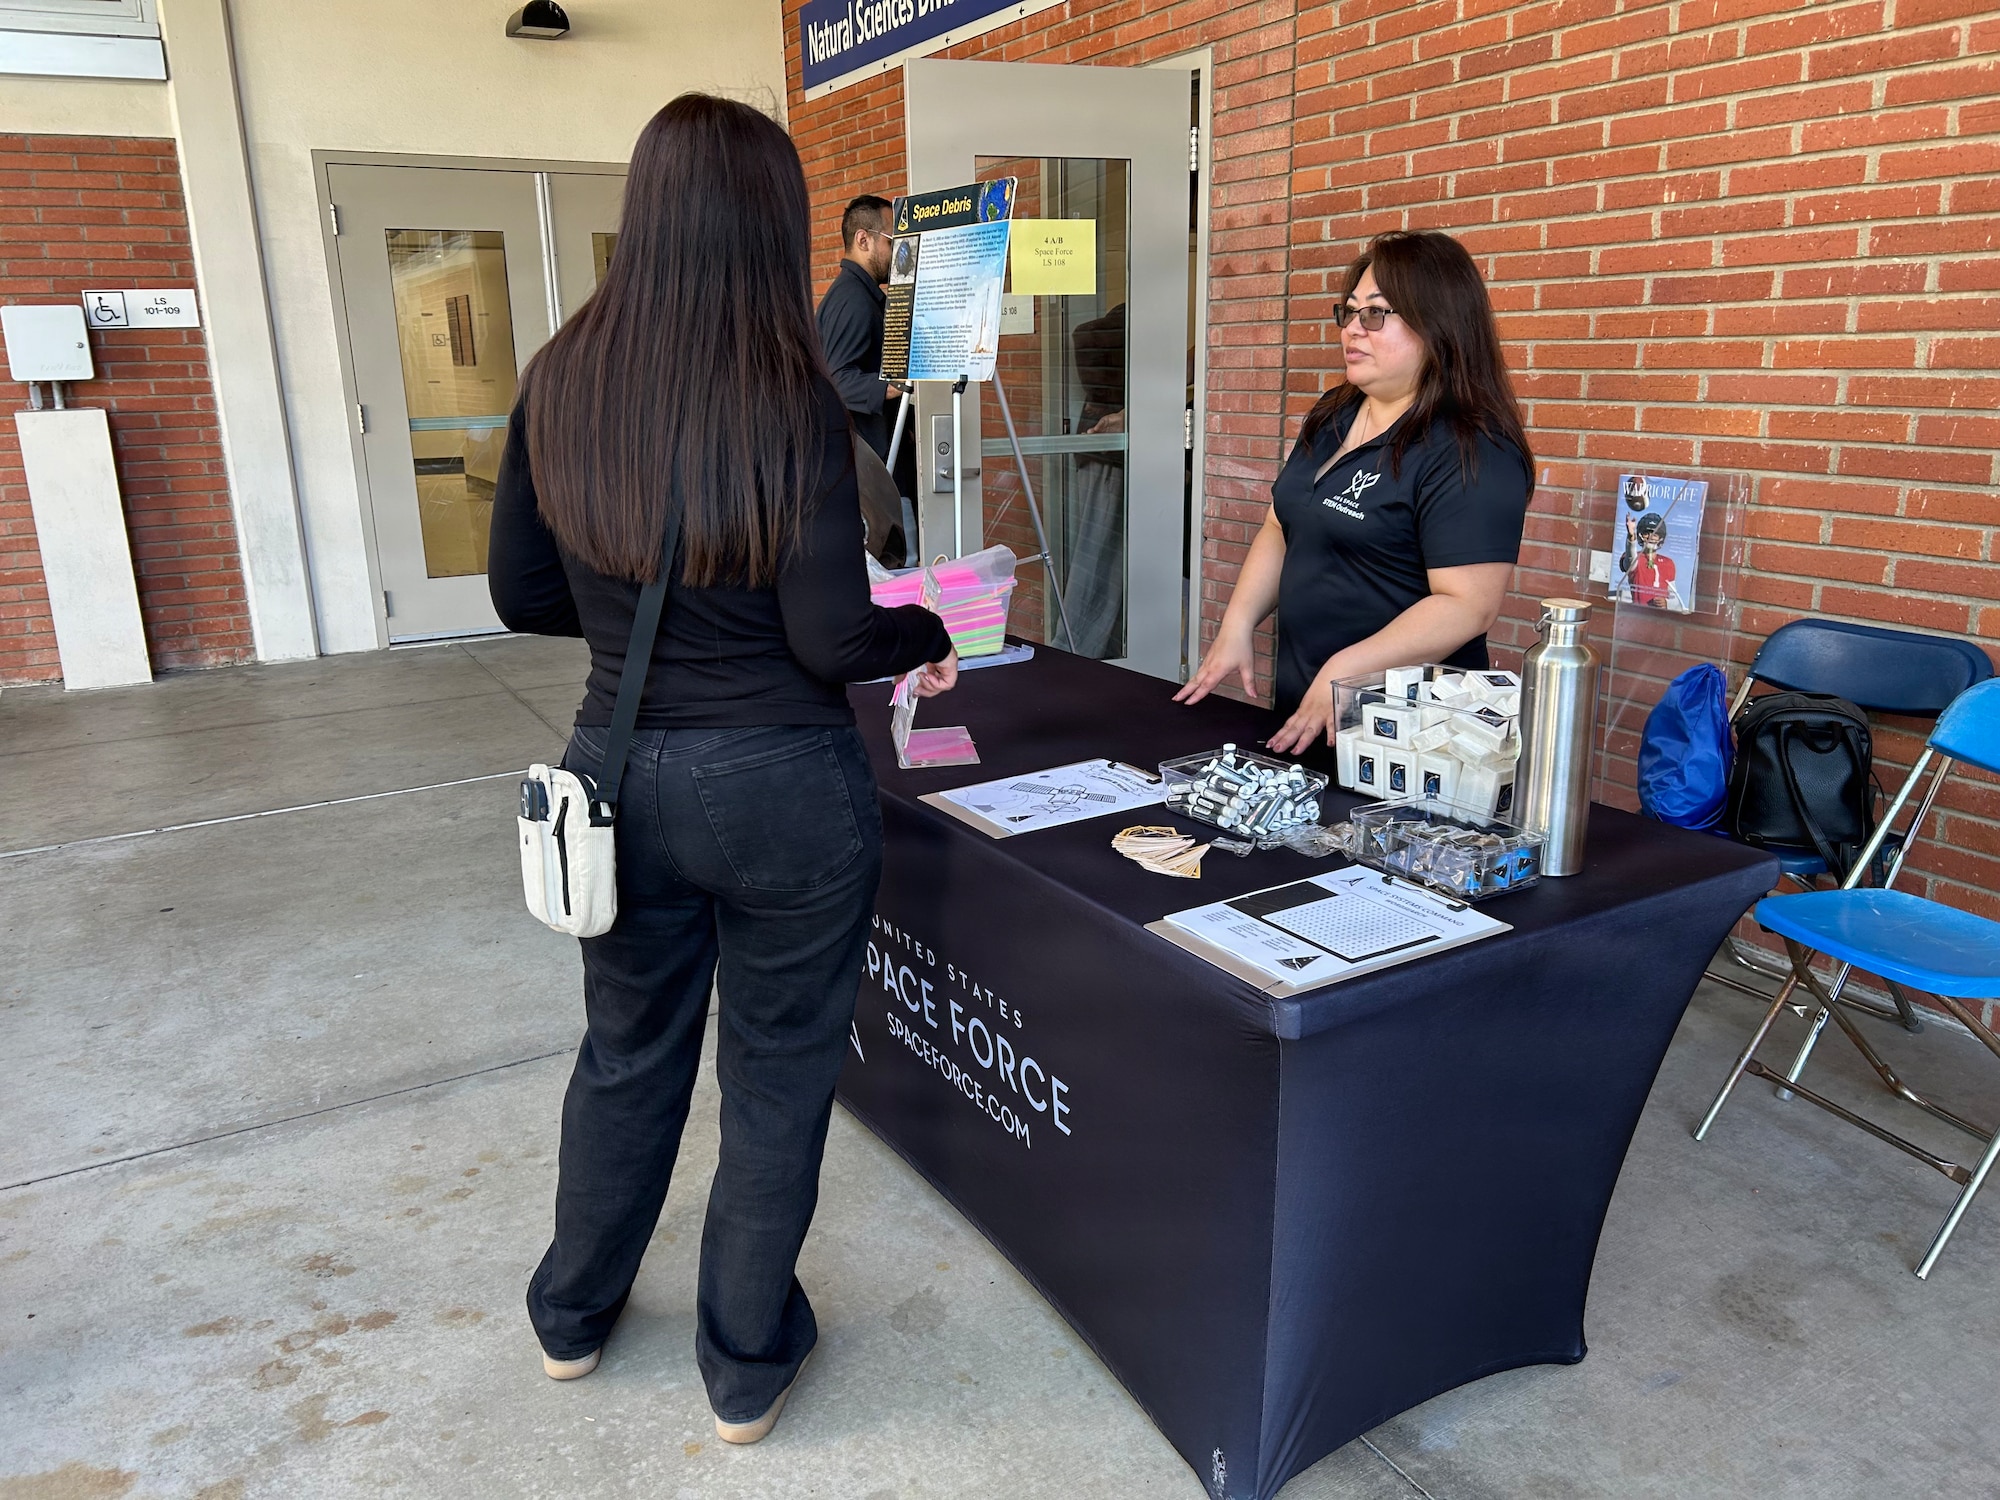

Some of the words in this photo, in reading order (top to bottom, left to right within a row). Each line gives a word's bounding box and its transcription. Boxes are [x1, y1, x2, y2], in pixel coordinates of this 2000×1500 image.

[808, 1, 853, 65] Natural
[856, 0, 914, 44] Sciences
[913, 204, 940, 222] Space
[942, 196, 972, 215] Debris
[1035, 248, 1053, 257] Space
[1055, 248, 1073, 256] Force
[144, 306, 181, 315] 101-109
[154, 297, 167, 305] LS
[1001, 307, 1008, 316] LS
[1009, 306, 1018, 315] 108
[1622, 482, 1671, 499] WARRIOR
[1322, 498, 1338, 509] STEM
[1336, 503, 1365, 520] Outreach
[1366, 885, 1392, 896] SPACE
[1389, 894, 1423, 909] SYSTEMS
[1422, 907, 1465, 927] COMMAND
[872, 914, 936, 967] UNITED
[947, 963, 1023, 1029] STATES
[863, 941, 939, 1029] PACE
[949, 999, 1072, 1136] FORCE
[886, 1012, 1031, 1149] SPACEFORCE.COM
